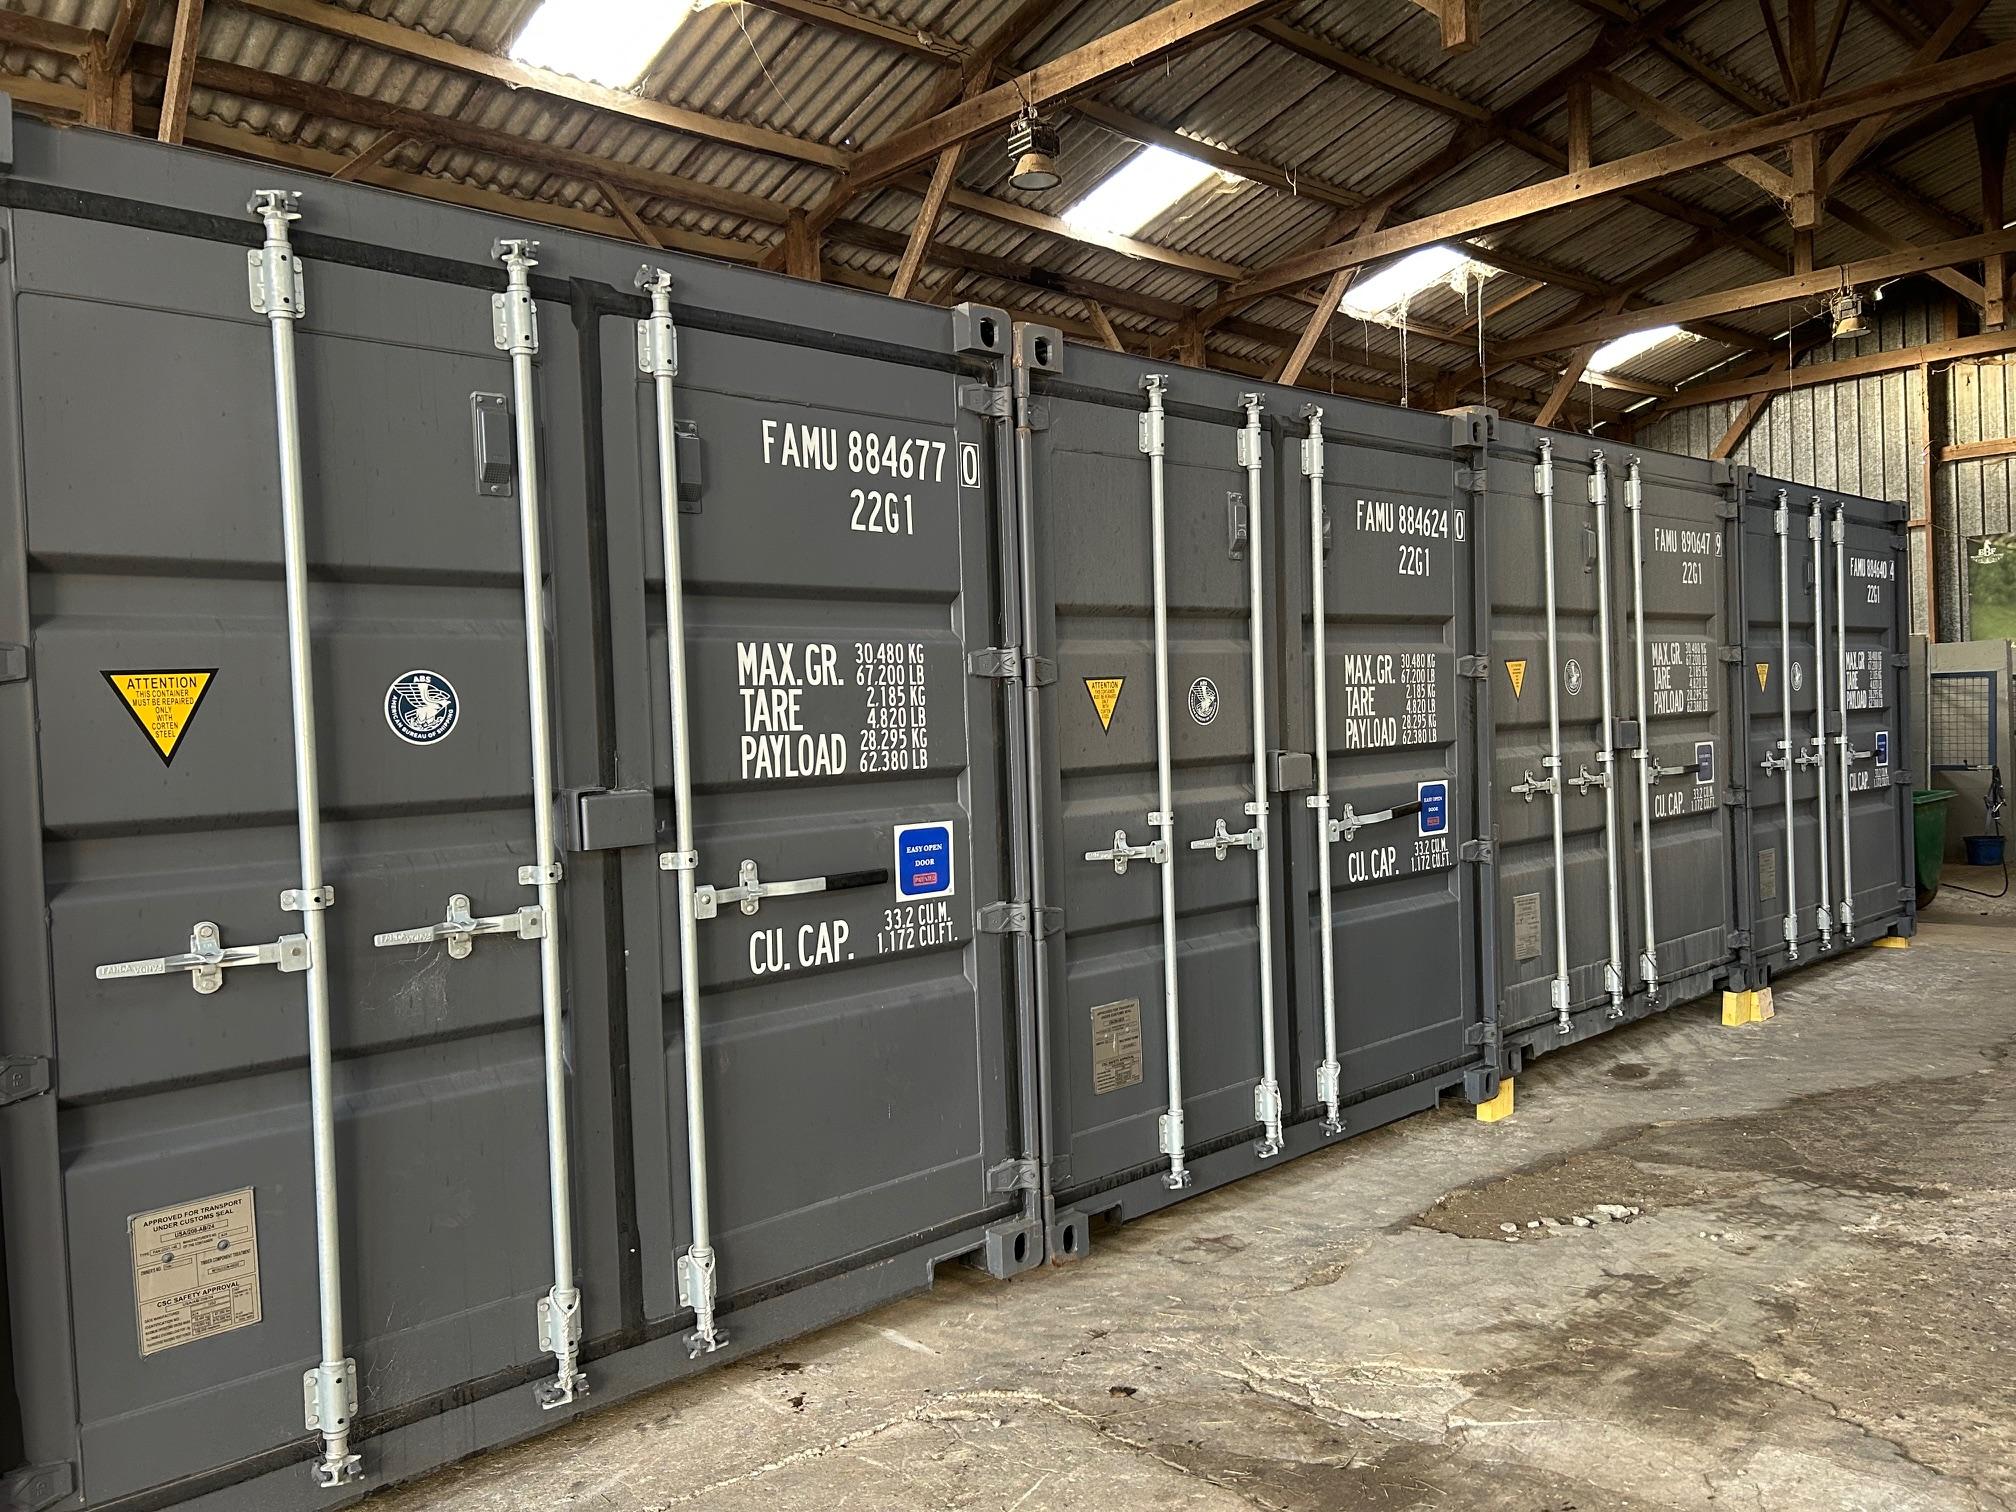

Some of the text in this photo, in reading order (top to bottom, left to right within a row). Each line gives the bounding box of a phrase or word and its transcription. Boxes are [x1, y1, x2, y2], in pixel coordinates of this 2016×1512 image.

[762, 420, 838, 471] FAMU
[848, 430, 946, 482] 884677
[850, 489, 913, 535] 22G1
[1357, 500, 1393, 532] FAMU
[1399, 505, 1447, 538] 884624
[1655, 528, 1720, 554] FAMU 890647 9
[1399, 545, 1429, 576] 22G1
[1850, 557, 1865, 576] FAMU
[1682, 561, 1702, 584] 22G1
[1867, 584, 1880, 603] 22G1
[855, 643, 904, 664] 30,480
[908, 644, 924, 664] KG
[1427, 654, 1435, 668] KG
[127, 677, 197, 690] ATTENTION
[857, 665, 924, 685] 67,200 LB
[1092, 681, 1118, 689] ATTENTION
[1427, 669, 1435, 683] LB
[1653, 667, 1671, 690] TARE
[1846, 671, 1858, 690] TARE
[136, 690, 150, 698] THIS
[152, 698, 160, 706] BE
[162, 697, 194, 705] REPAIRED
[1345, 686, 1375, 716] TARE
[1427, 684, 1436, 697] KG
[1654, 690, 1684, 714] PAYLOAD
[1847, 690, 1867, 709] PAYLOAD
[740, 686, 926, 732] TARE 2,185 KG
[1428, 699, 1435, 713] LB
[152, 722, 178, 730] CORTEN
[867, 707, 926, 728] 4,820 LB
[156, 730, 175, 738] STEEL
[402, 727, 426, 738] BUREAU
[1346, 718, 1396, 749] PAYLOAD
[1428, 714, 1436, 728] KG
[1428, 729, 1437, 743] LB
[741, 728, 927, 779] PAYLOAD 28,295 KG
[860, 749, 928, 772] 62,380 LB
[1655, 794, 1666, 817] CU.
[1669, 792, 1684, 815] CAP.
[1414, 840, 1429, 856] 33.2
[915, 859, 934, 867] DOOR
[1348, 851, 1368, 882] CU.
[1371, 847, 1399, 878] CAP.
[1432, 852, 1452, 868] CU.FT.
[884, 901, 951, 930] 33.2 CU.M.
[750, 920, 958, 975] CU. CAP. 1,172 CU.FT.
[143, 1199, 242, 1227] APPROVED FOR TRANSPORT
[153, 1209, 234, 1232] UNDER CUSTOMS SEAL
[157, 1281, 239, 1308] CSC SAFETY APPROVAL
